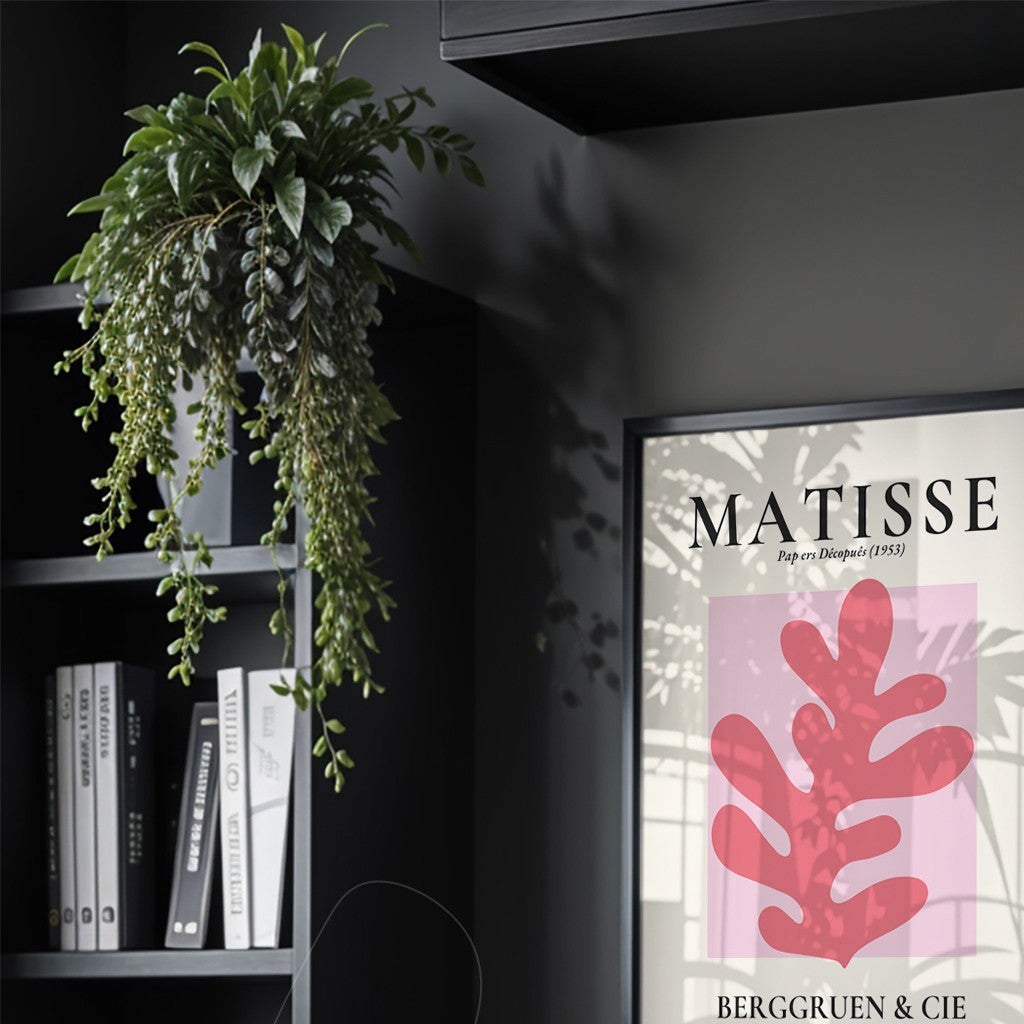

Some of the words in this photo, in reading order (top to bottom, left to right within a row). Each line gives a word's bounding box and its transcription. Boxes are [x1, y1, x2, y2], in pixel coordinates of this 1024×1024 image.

[688, 476, 999, 549] MATISSE
[869, 542, 906, 560] (1953)
[717, 995, 886, 1020] BERGGRUEN
[893, 994, 914, 1020] &
[921, 994, 967, 1020] CIE
